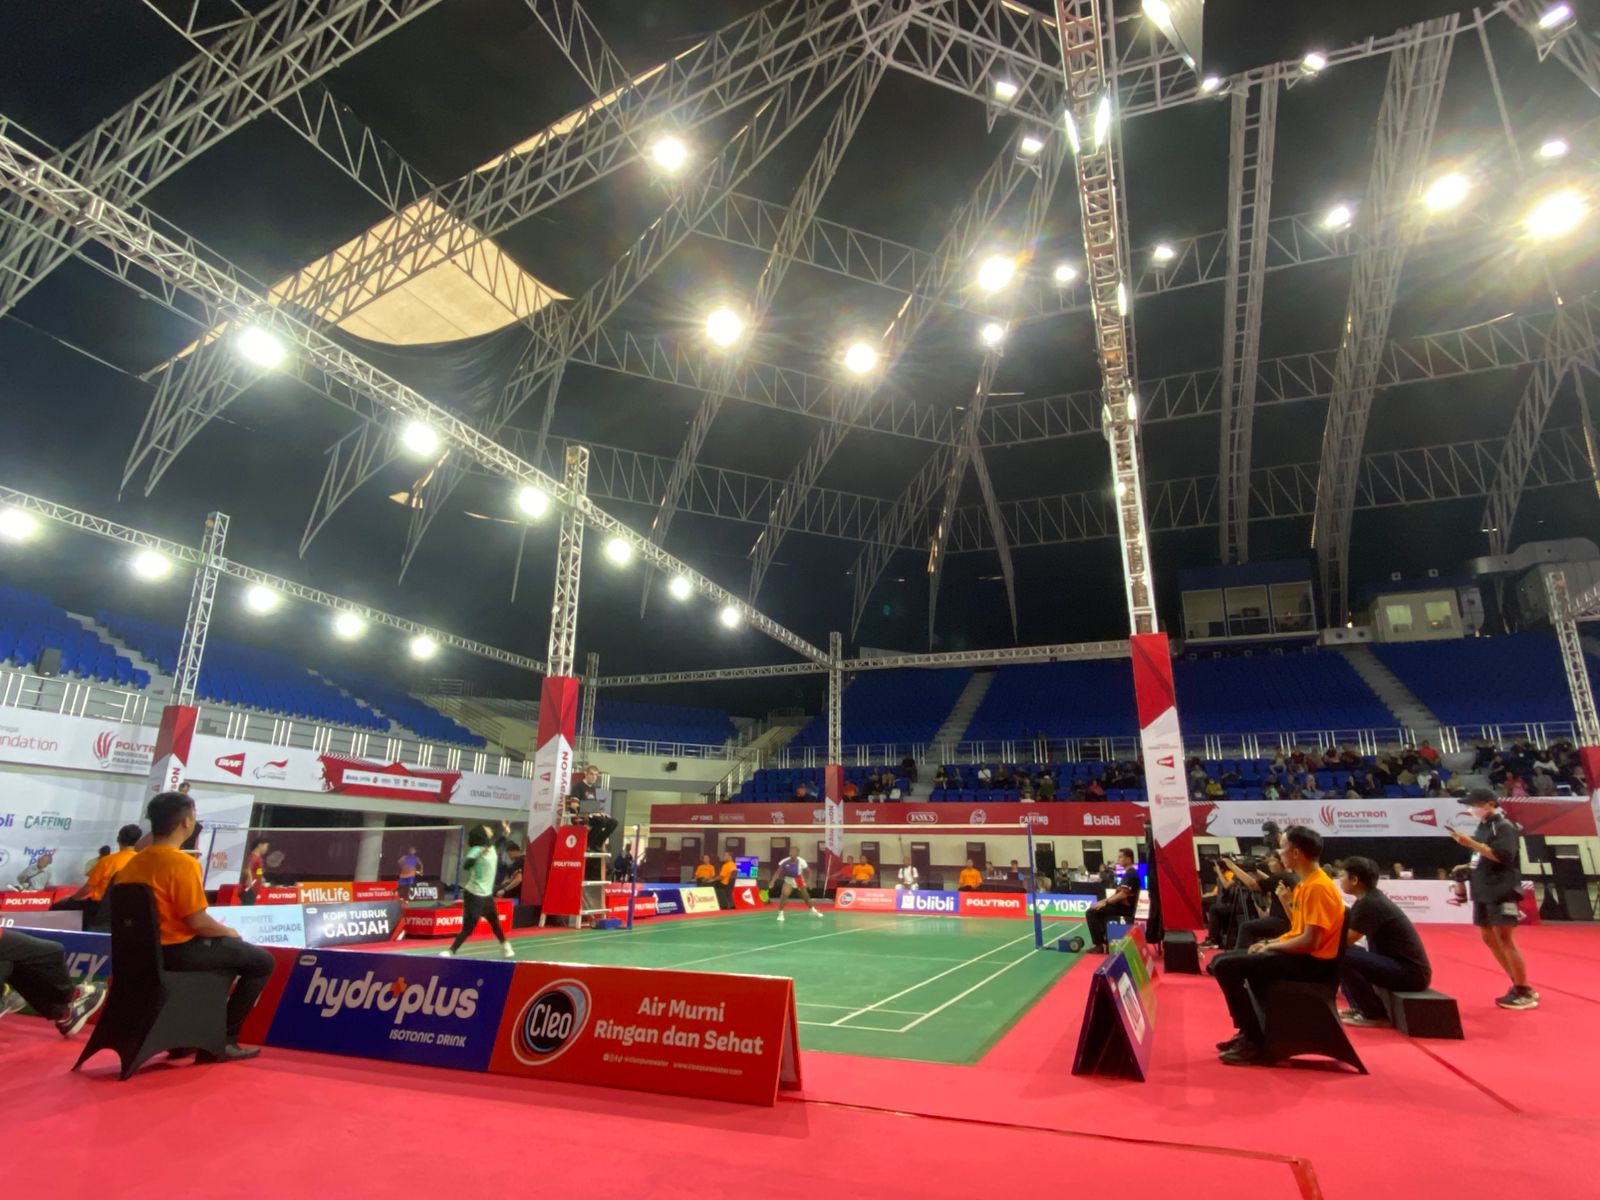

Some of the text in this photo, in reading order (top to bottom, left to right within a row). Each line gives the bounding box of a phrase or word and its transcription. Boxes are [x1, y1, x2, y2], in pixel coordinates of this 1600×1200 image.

[0, 735, 58, 751] ndation
[115, 740, 156, 752] POLYTR
[1094, 815, 1121, 826] blibli
[1337, 810, 1387, 818] POLYTRON
[301, 888, 350, 902] MilkLife
[5, 898, 51, 906] POLYTRON
[916, 895, 954, 911] blibli
[966, 898, 1020, 908] POLYTRON
[1053, 900, 1093, 912] YONEX
[323, 911, 347, 921] KOPI
[350, 909, 388, 919] TUBRUK
[436, 916, 464, 927] POLYTR
[324, 920, 390, 938] GADJAH
[638, 997, 725, 1022] Air Murni
[530, 1004, 572, 1038] Cleo
[389, 1029, 467, 1047] ISOTONIC DRINK
[594, 1020, 763, 1055] Ringan dan Sehat
